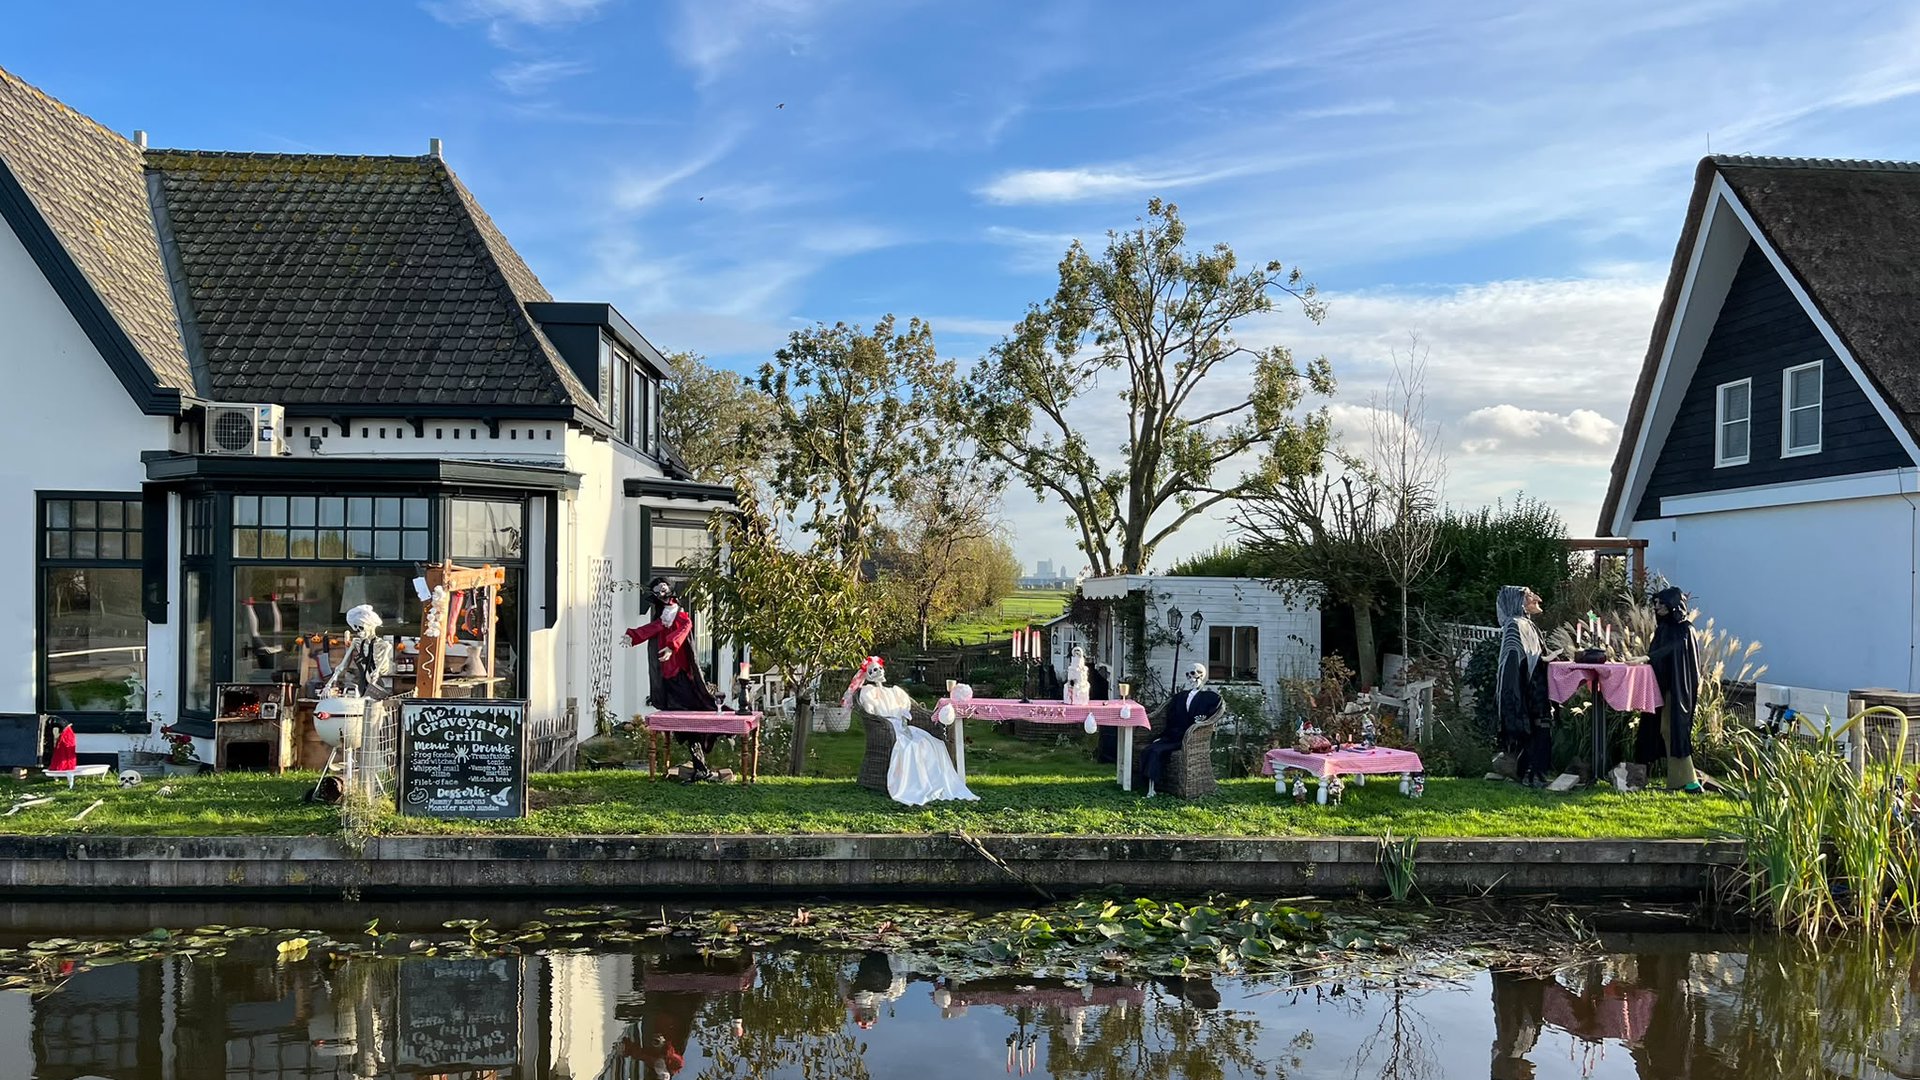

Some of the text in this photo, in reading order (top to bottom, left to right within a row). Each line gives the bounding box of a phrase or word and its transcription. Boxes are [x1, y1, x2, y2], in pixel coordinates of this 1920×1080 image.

[422, 709, 446, 722] The
[417, 717, 509, 739] Graveyard
[443, 730, 482, 741] Grill
[472, 742, 515, 754] Drinks:
[414, 751, 432, 760] Frog
[437, 785, 490, 799] Desserts:
